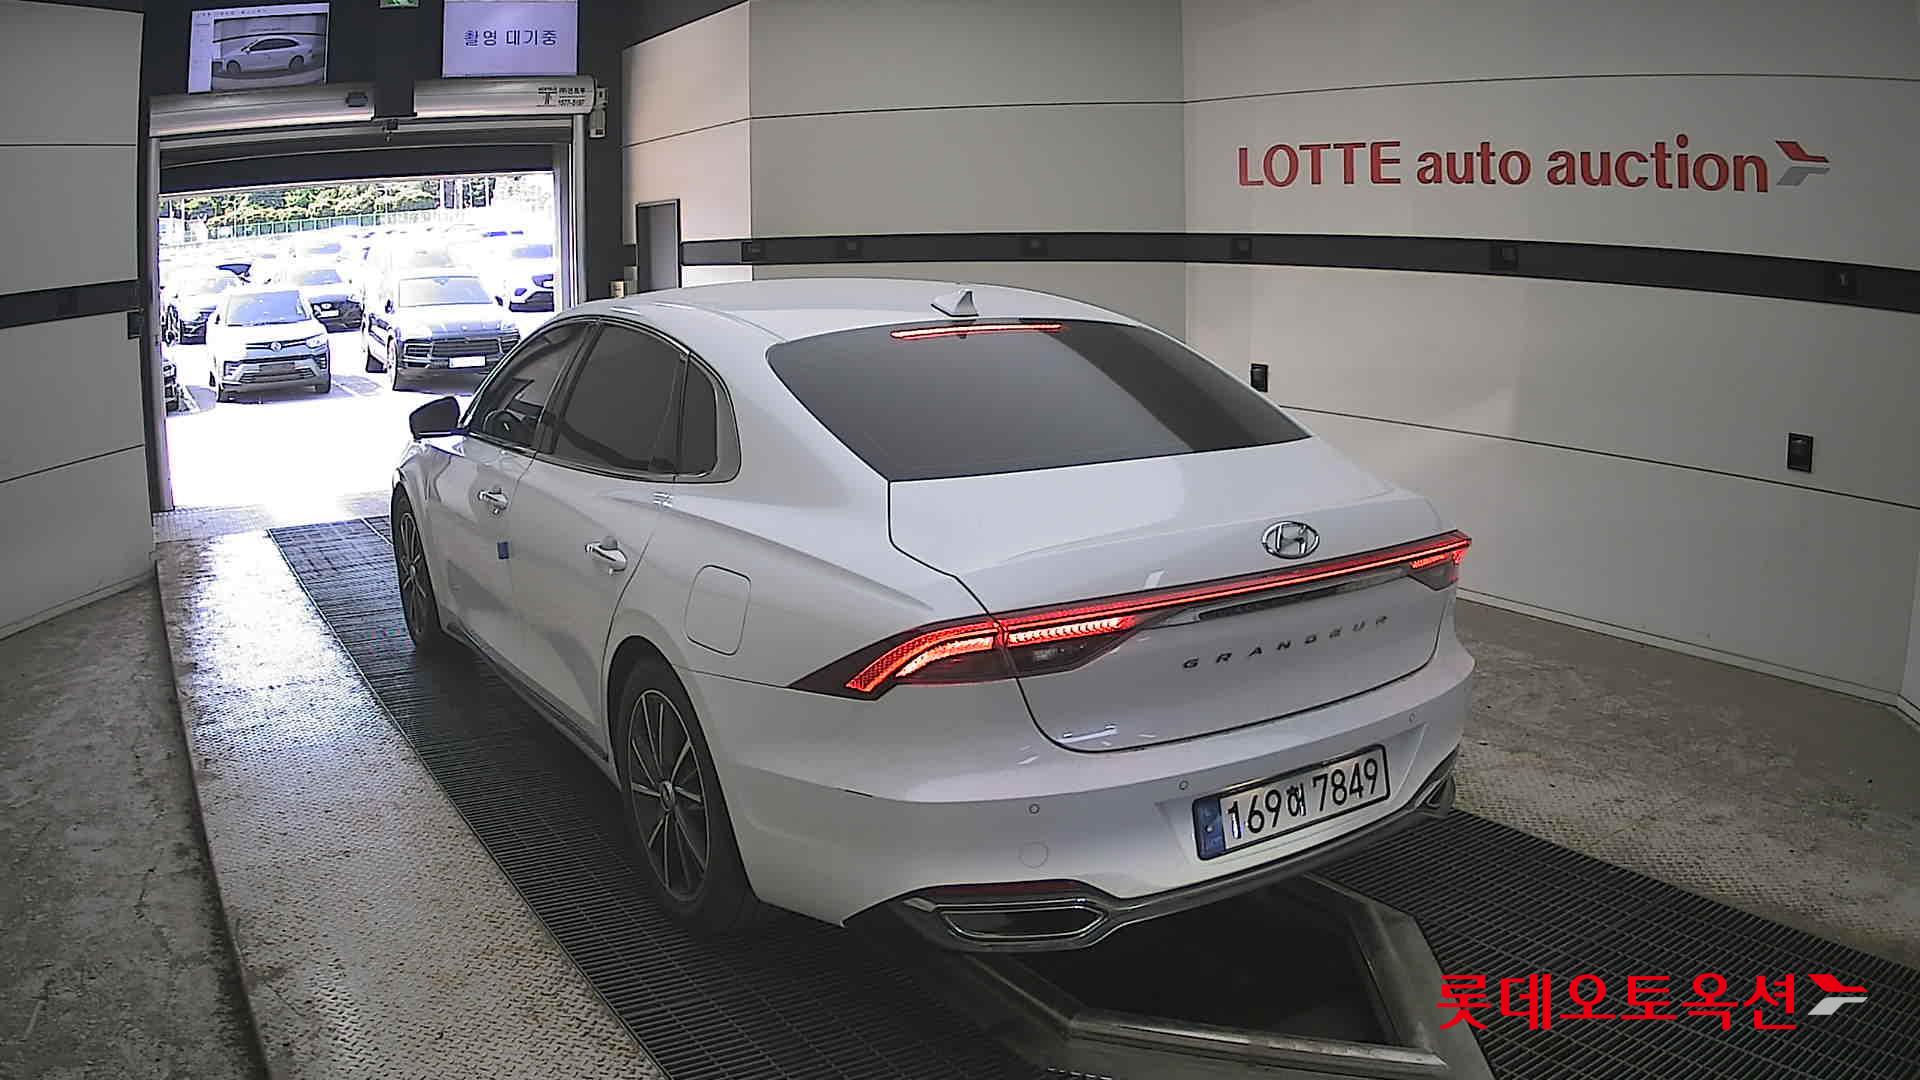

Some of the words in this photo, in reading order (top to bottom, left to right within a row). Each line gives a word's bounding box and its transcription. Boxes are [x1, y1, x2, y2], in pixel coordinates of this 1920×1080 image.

[505, 29, 557, 46] 대기중
[1238, 141, 1401, 187] LOTTE
[1416, 141, 1532, 186] auto
[1546, 134, 1769, 193] auction
[1182, 615, 1387, 669] GRANDEUR
[1312, 758, 1378, 812] 7849
